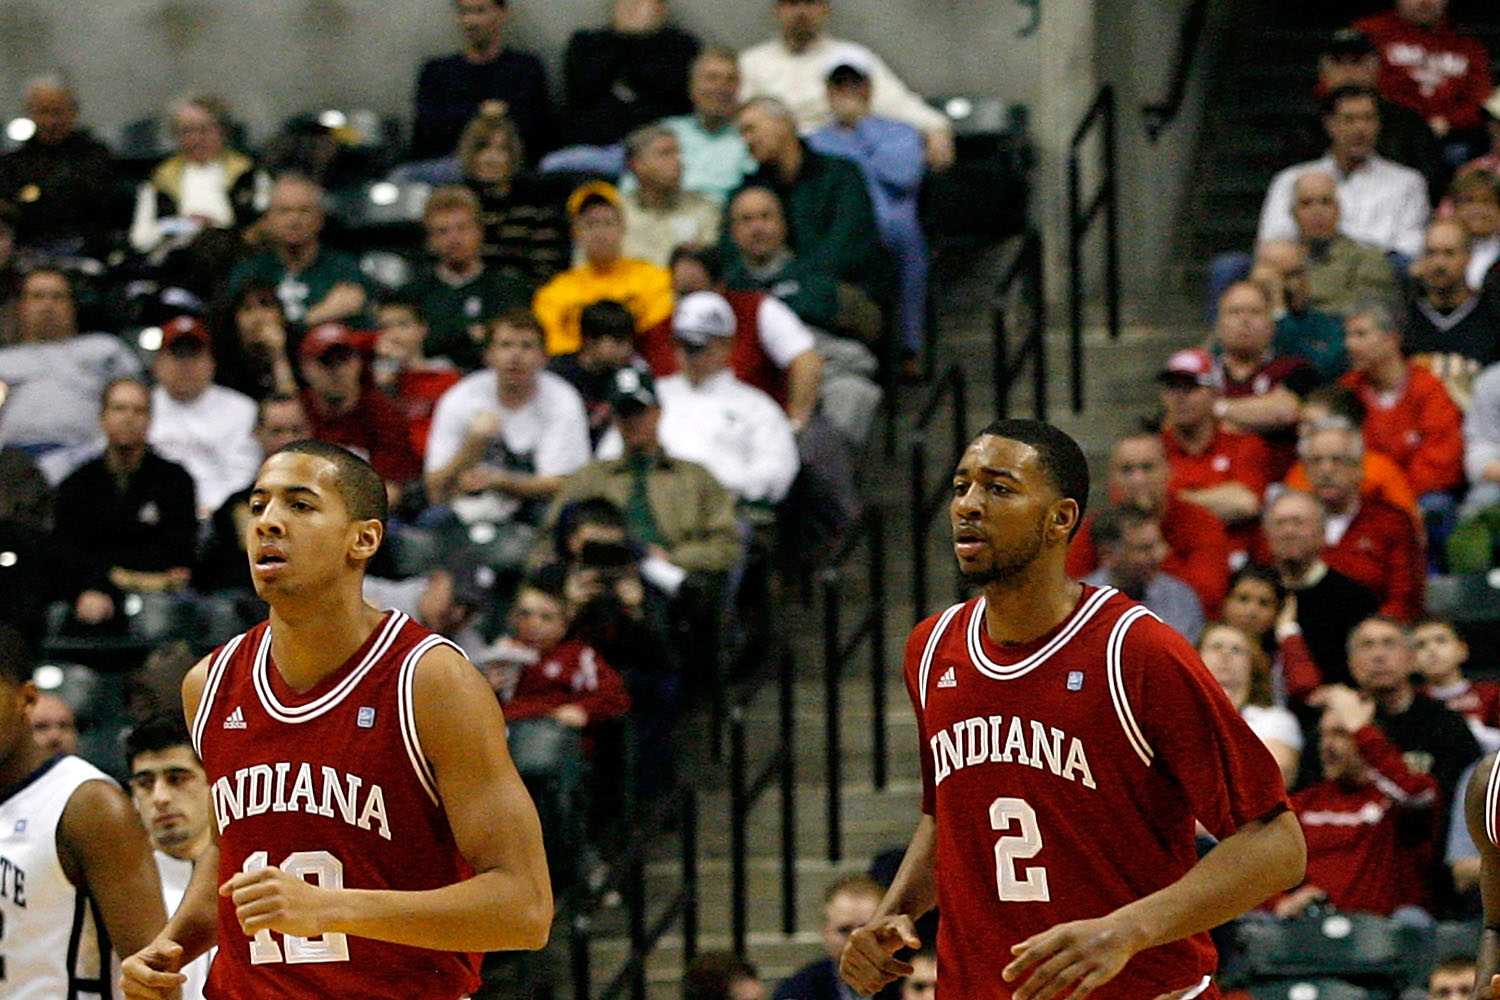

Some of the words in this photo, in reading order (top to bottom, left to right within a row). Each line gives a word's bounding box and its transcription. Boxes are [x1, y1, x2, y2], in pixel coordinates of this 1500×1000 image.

[929, 715, 1097, 790] INDIANA
[211, 762, 392, 841] INDIANA
[989, 797, 1050, 902] 2
